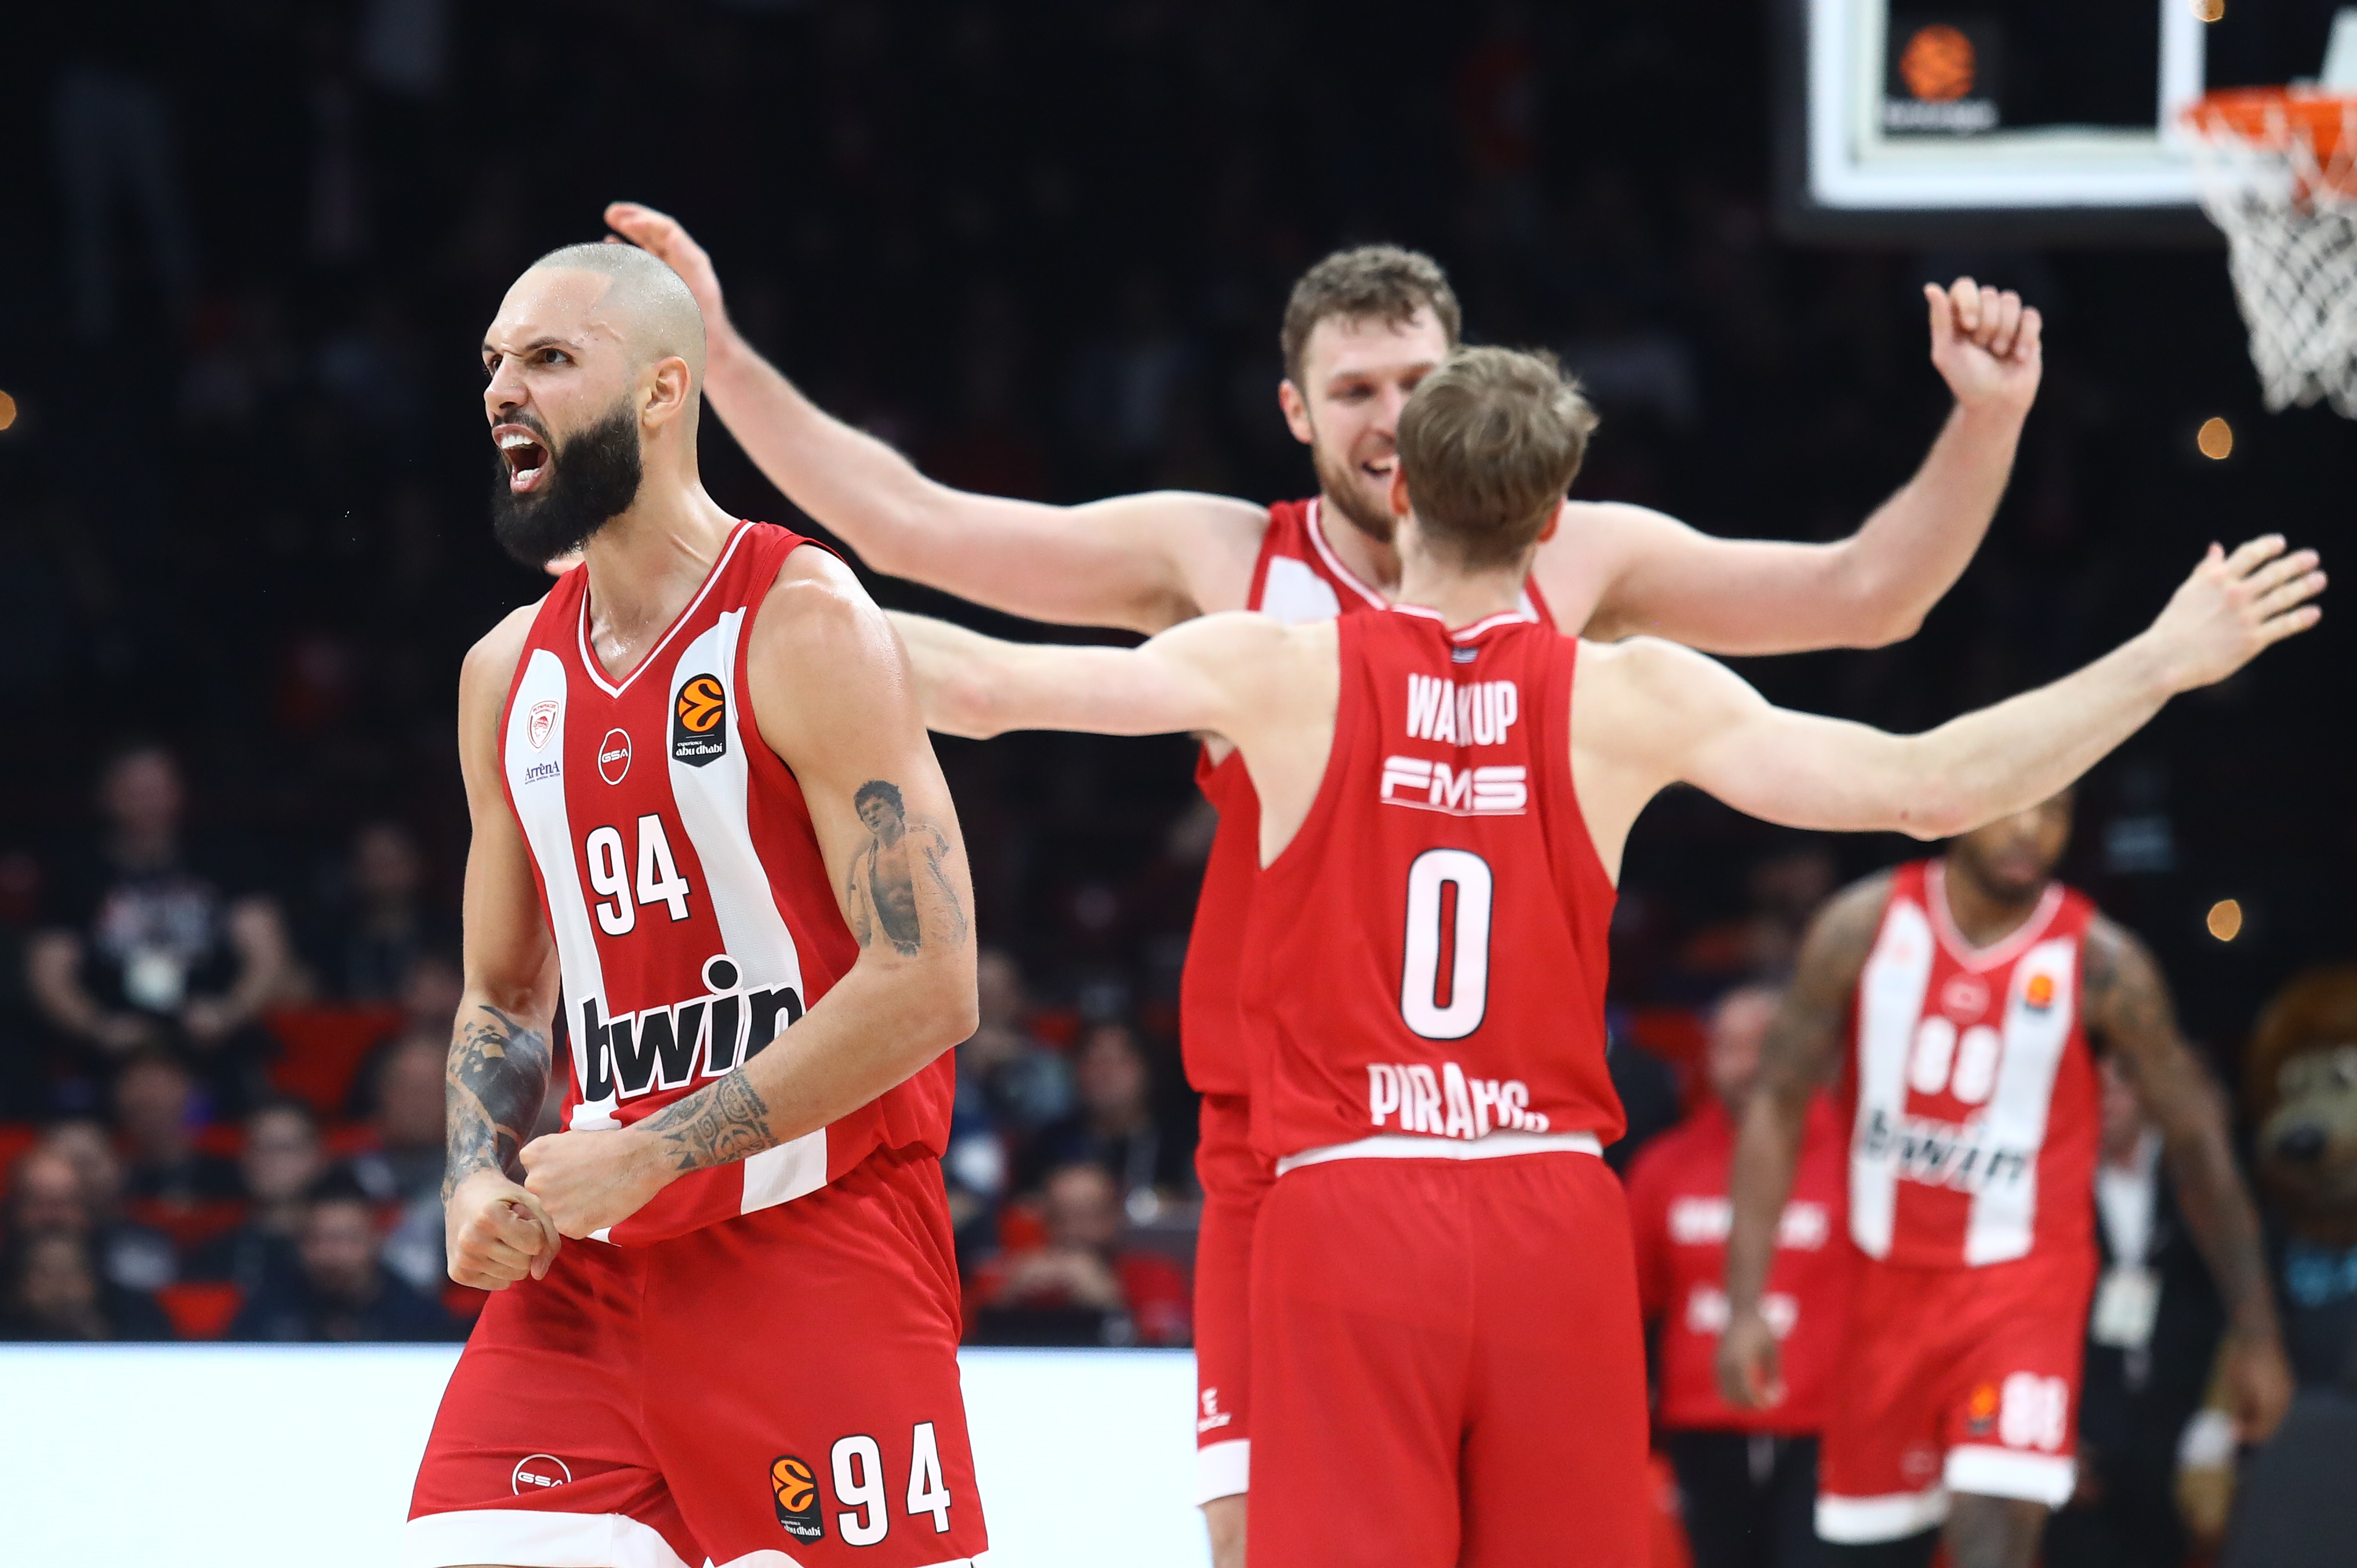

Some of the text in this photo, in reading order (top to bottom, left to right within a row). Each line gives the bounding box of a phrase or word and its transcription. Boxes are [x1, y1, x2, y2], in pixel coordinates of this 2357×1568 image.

[601, 748, 628, 763] GSA
[676, 743, 723, 756] abu dhabi
[1380, 755, 1528, 813] FMS
[585, 813, 691, 936] 94
[1399, 847, 1494, 1040] 0
[578, 953, 807, 1103] bwin
[829, 1421, 951, 1547] 94
[796, 1526, 821, 1536] dhabi
